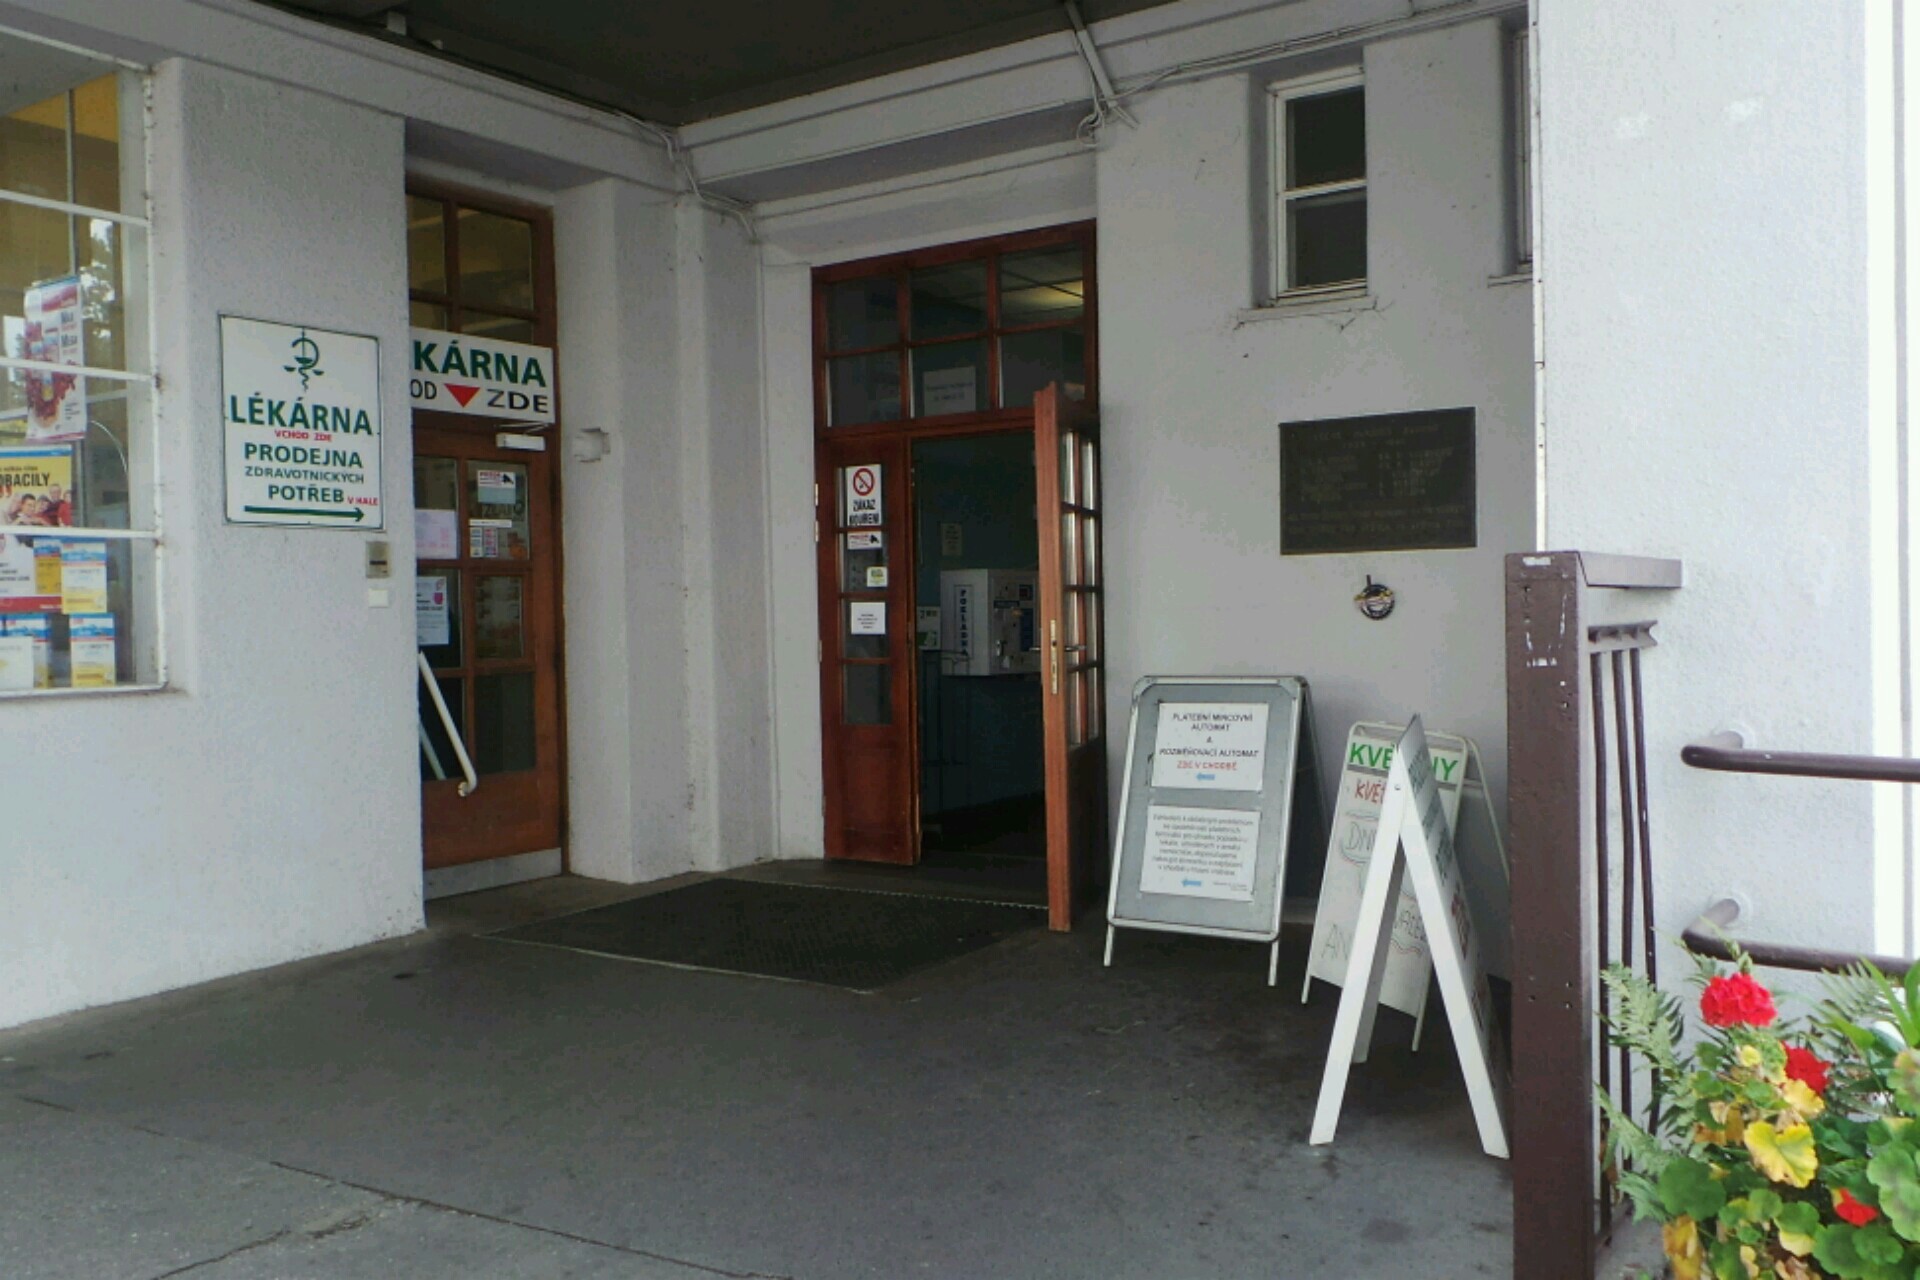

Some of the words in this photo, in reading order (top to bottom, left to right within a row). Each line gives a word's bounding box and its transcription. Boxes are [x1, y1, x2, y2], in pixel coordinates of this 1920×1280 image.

[413, 339, 547, 388] KÁRNA
[410, 379, 437, 400] OD
[486, 388, 549, 414] ZDE
[230, 391, 373, 436] LÉKÁRNA
[274, 429, 310, 440] VCHOD
[313, 432, 333, 442] ZDE
[243, 441, 364, 469] PRODEJNA
[267, 483, 344, 504] POTŘEB
[355, 497, 379, 506] HALE
[1191, 723, 1231, 732] AUTOMAT
[1219, 748, 1260, 758] AUTOMAT
